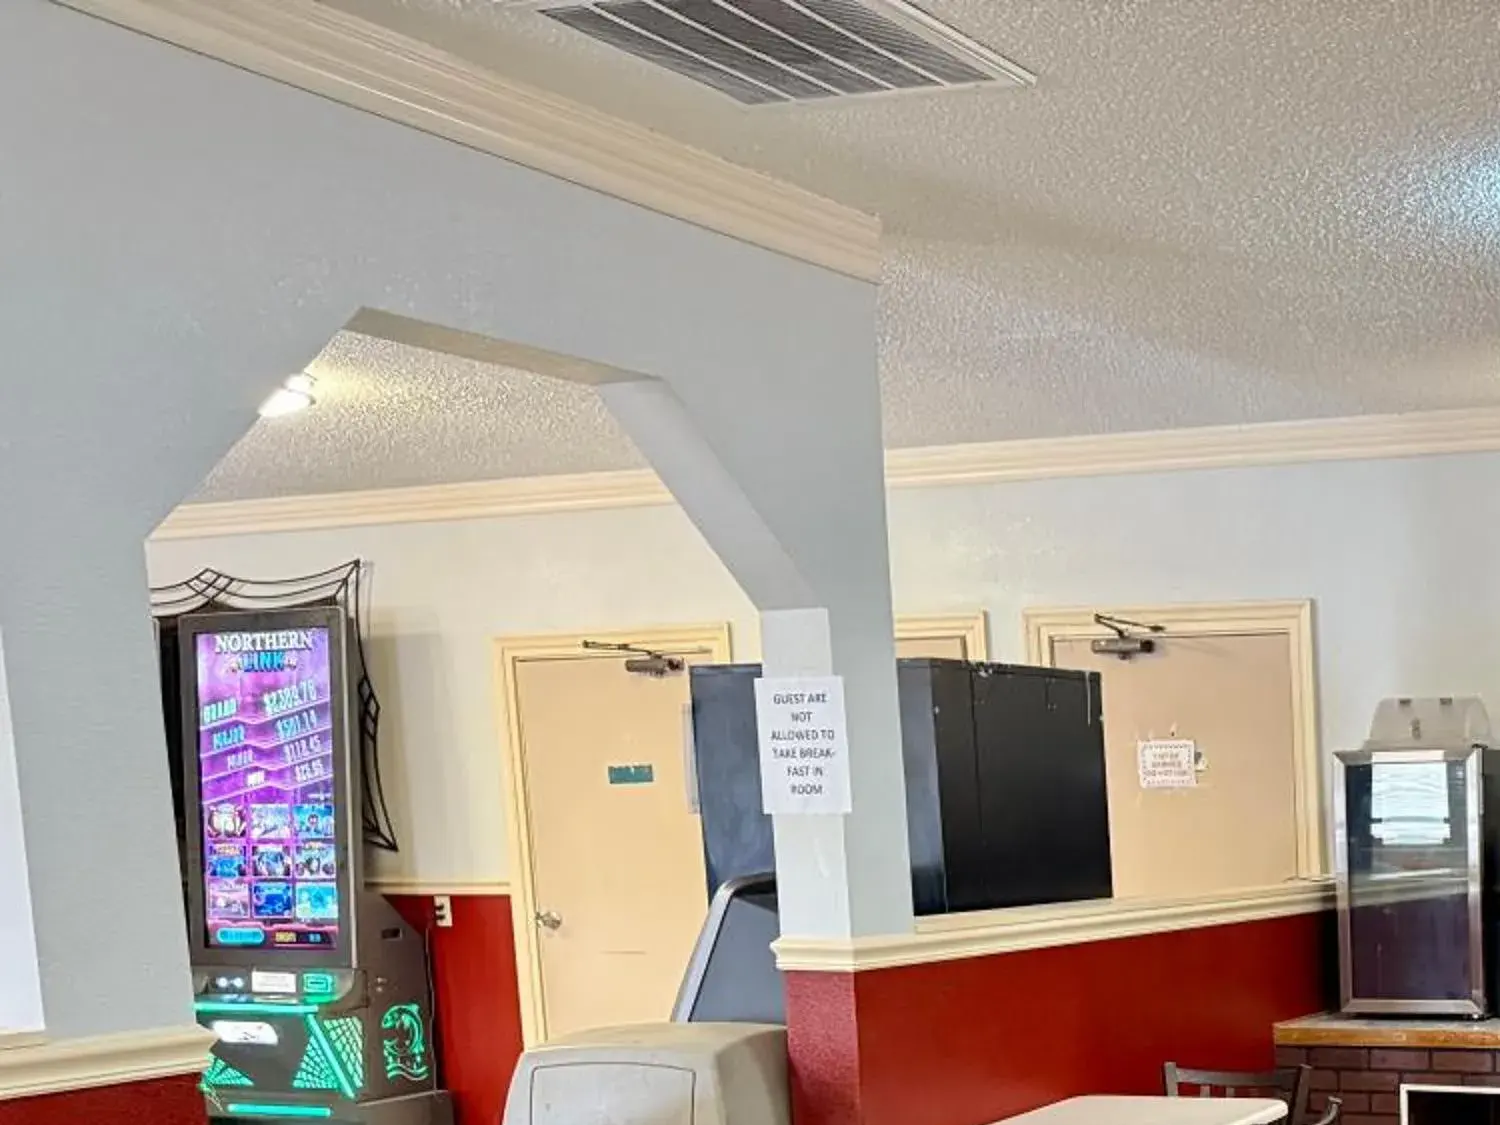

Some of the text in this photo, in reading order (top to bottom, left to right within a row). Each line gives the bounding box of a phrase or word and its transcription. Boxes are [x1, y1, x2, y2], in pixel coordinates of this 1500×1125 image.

[214, 630, 314, 653] NORTHERN
[773, 692, 828, 705] GUEST ARE
[791, 711, 813, 723] NOT
[771, 729, 835, 741] ALLOWED TO
[772, 748, 798, 759] TAKE
[787, 766, 824, 777] FAST IN
[790, 784, 823, 795] ROOM
